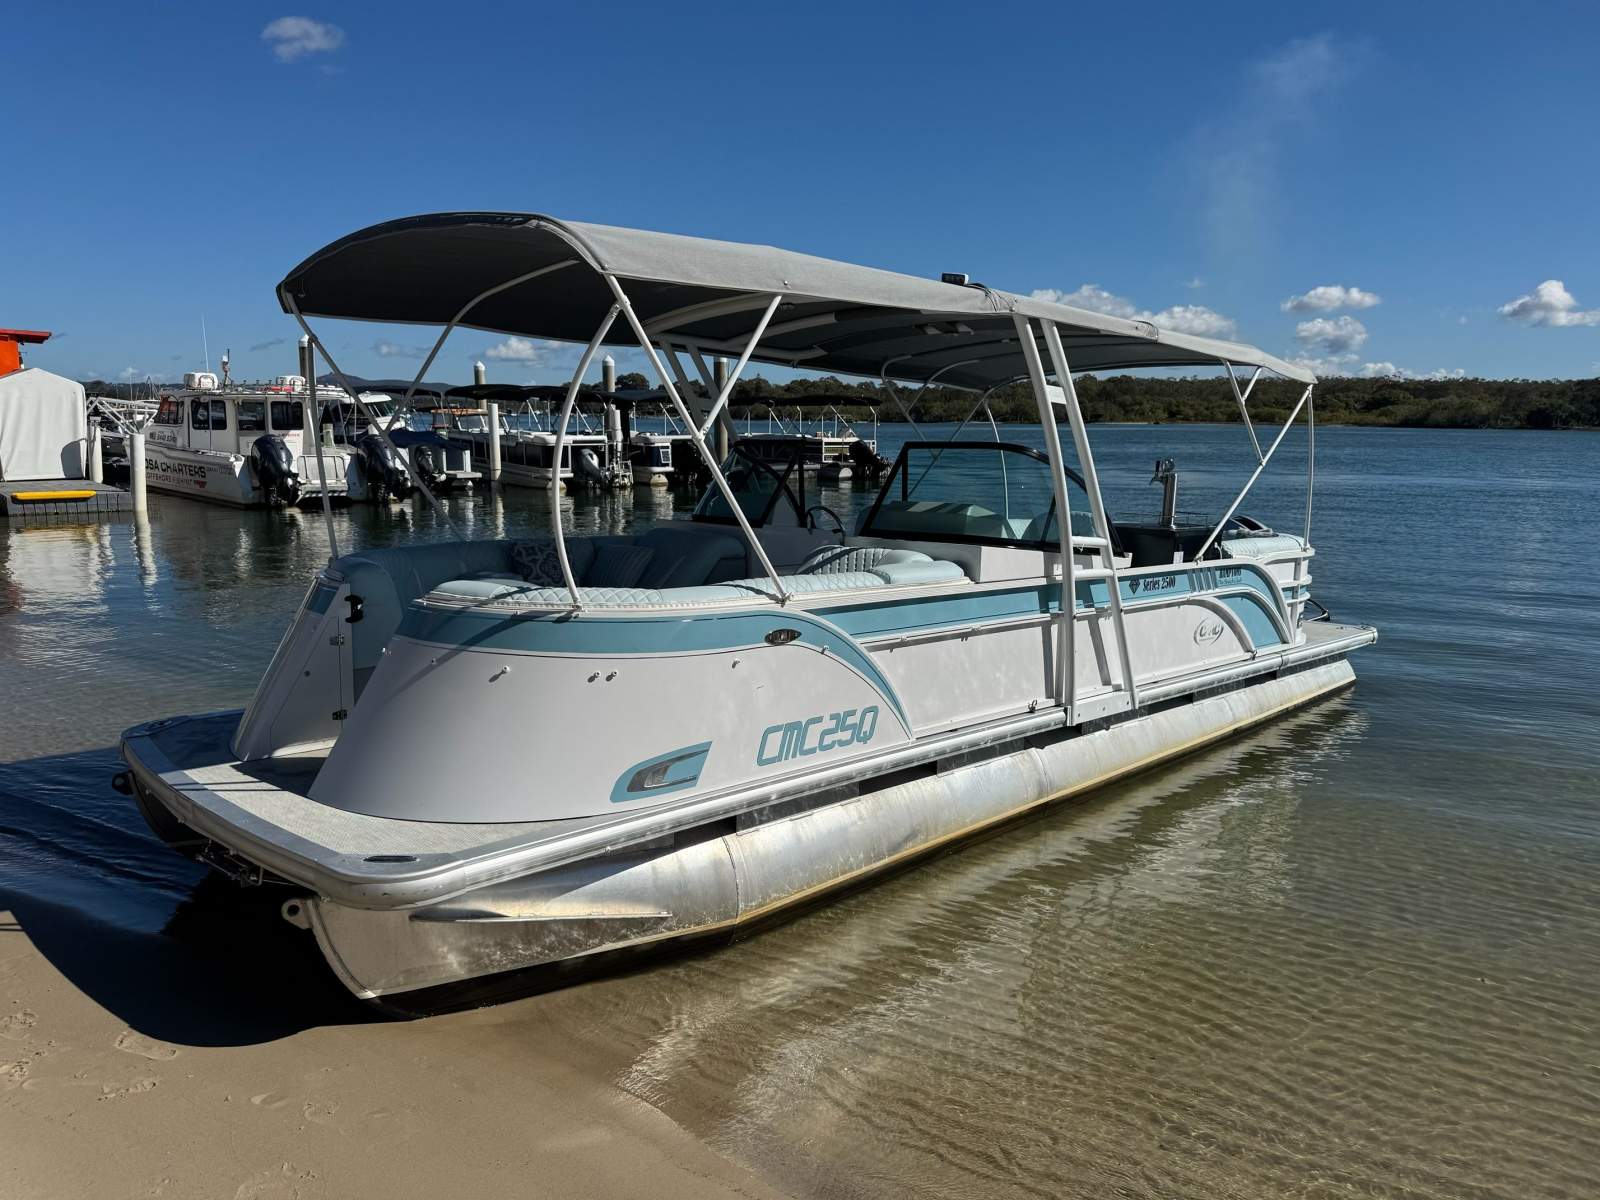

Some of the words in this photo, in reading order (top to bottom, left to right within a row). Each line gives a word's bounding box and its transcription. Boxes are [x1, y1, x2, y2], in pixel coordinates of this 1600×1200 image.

[160, 461, 207, 478] CHARTERS
[1143, 577, 1160, 592] Series
[1161, 575, 1176, 590] 2500
